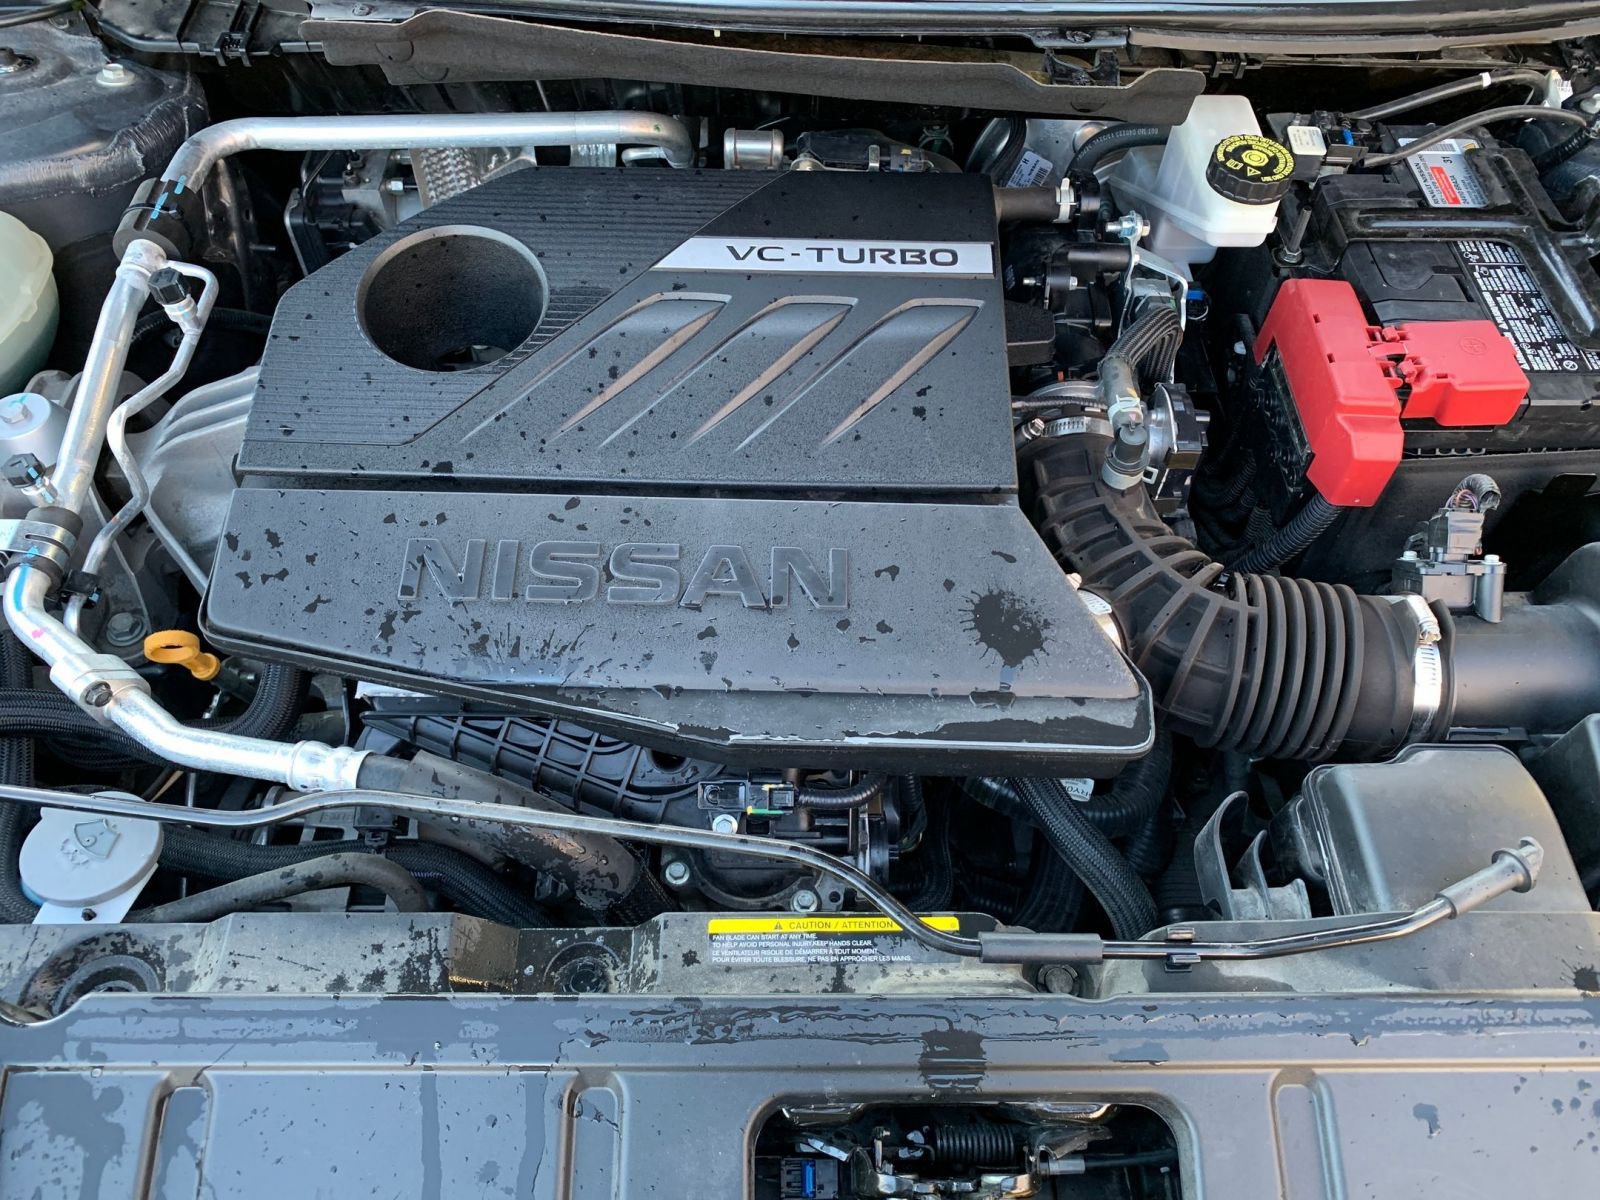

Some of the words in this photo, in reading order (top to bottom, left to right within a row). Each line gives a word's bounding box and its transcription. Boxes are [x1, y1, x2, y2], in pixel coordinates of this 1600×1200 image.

[1413, 162, 1428, 183] NISSAN
[726, 245, 959, 267] VC-TURBO
[399, 537, 849, 609] NISSAN
[789, 921, 831, 930] CAUTION
[842, 920, 894, 929] ATTENTION
